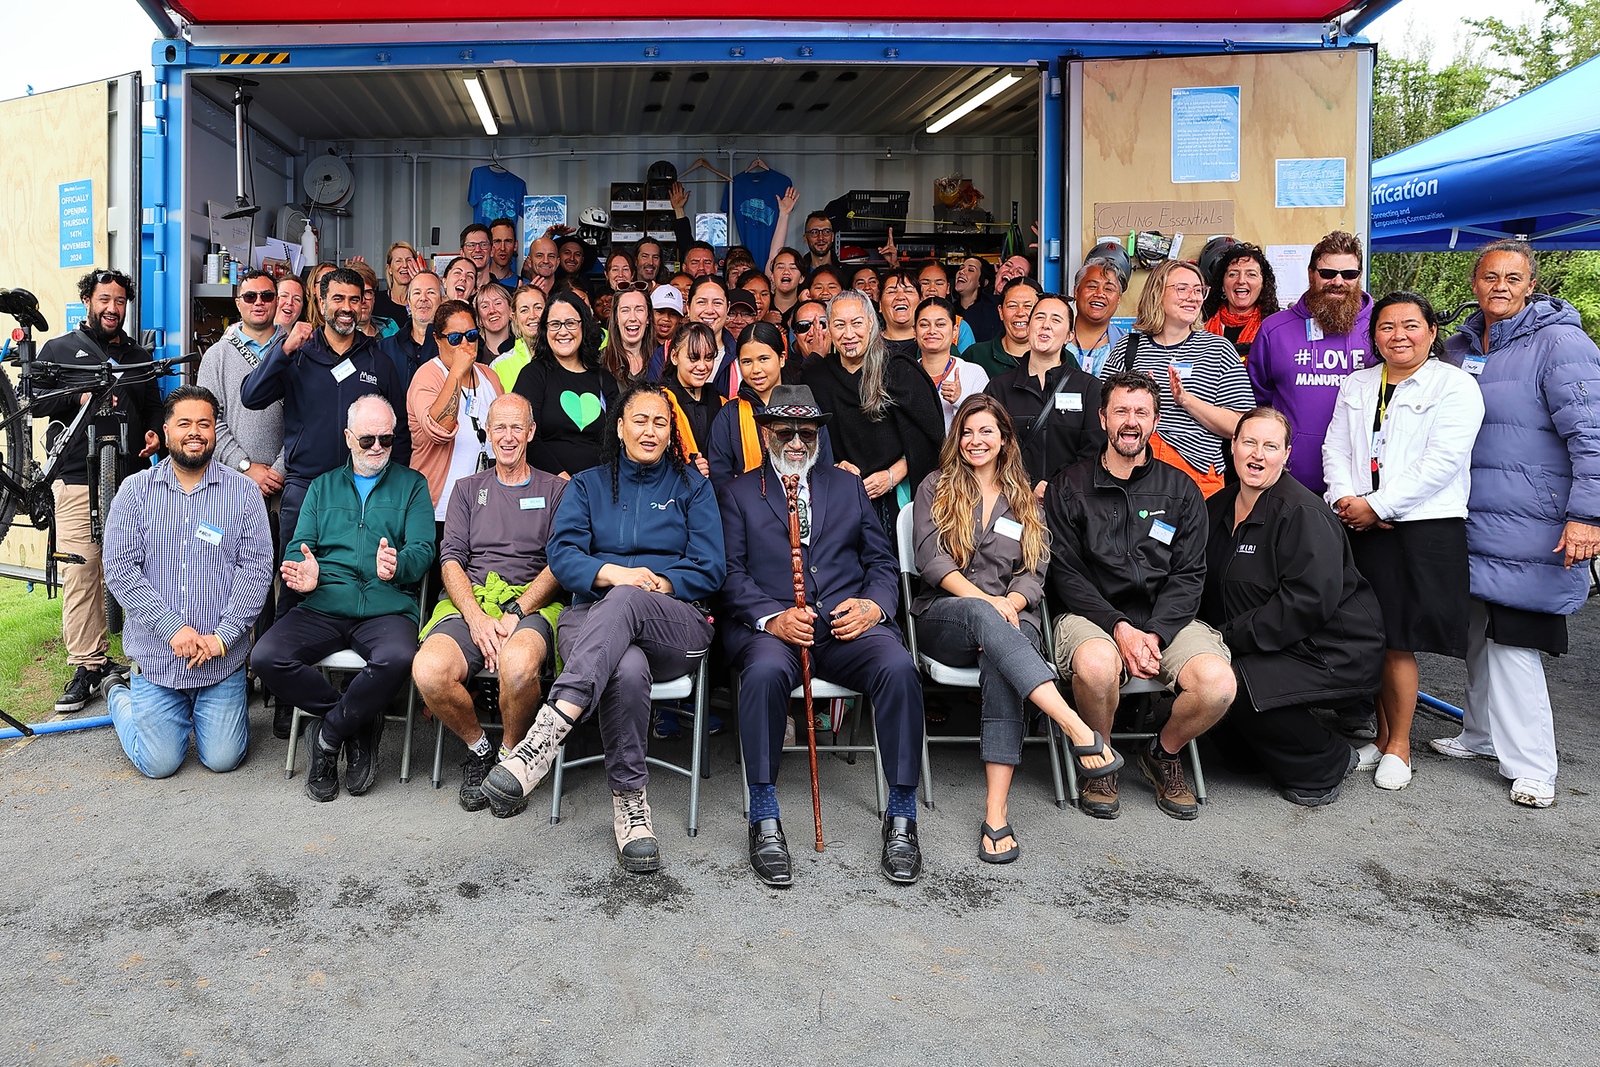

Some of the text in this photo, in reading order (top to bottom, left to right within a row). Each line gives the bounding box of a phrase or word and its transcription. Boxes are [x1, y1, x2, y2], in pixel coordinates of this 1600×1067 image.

[1371, 177, 1438, 206] ification
[61, 194, 89, 205] OFFICIALLY
[64, 206, 87, 216] OPENING
[62, 217, 89, 228] THURSDAY
[1374, 212, 1445, 227] Empowering Communities
[62, 240, 91, 251] NOVEMBER
[70, 253, 82, 262] 2024
[1295, 373, 1348, 386] MANURE
